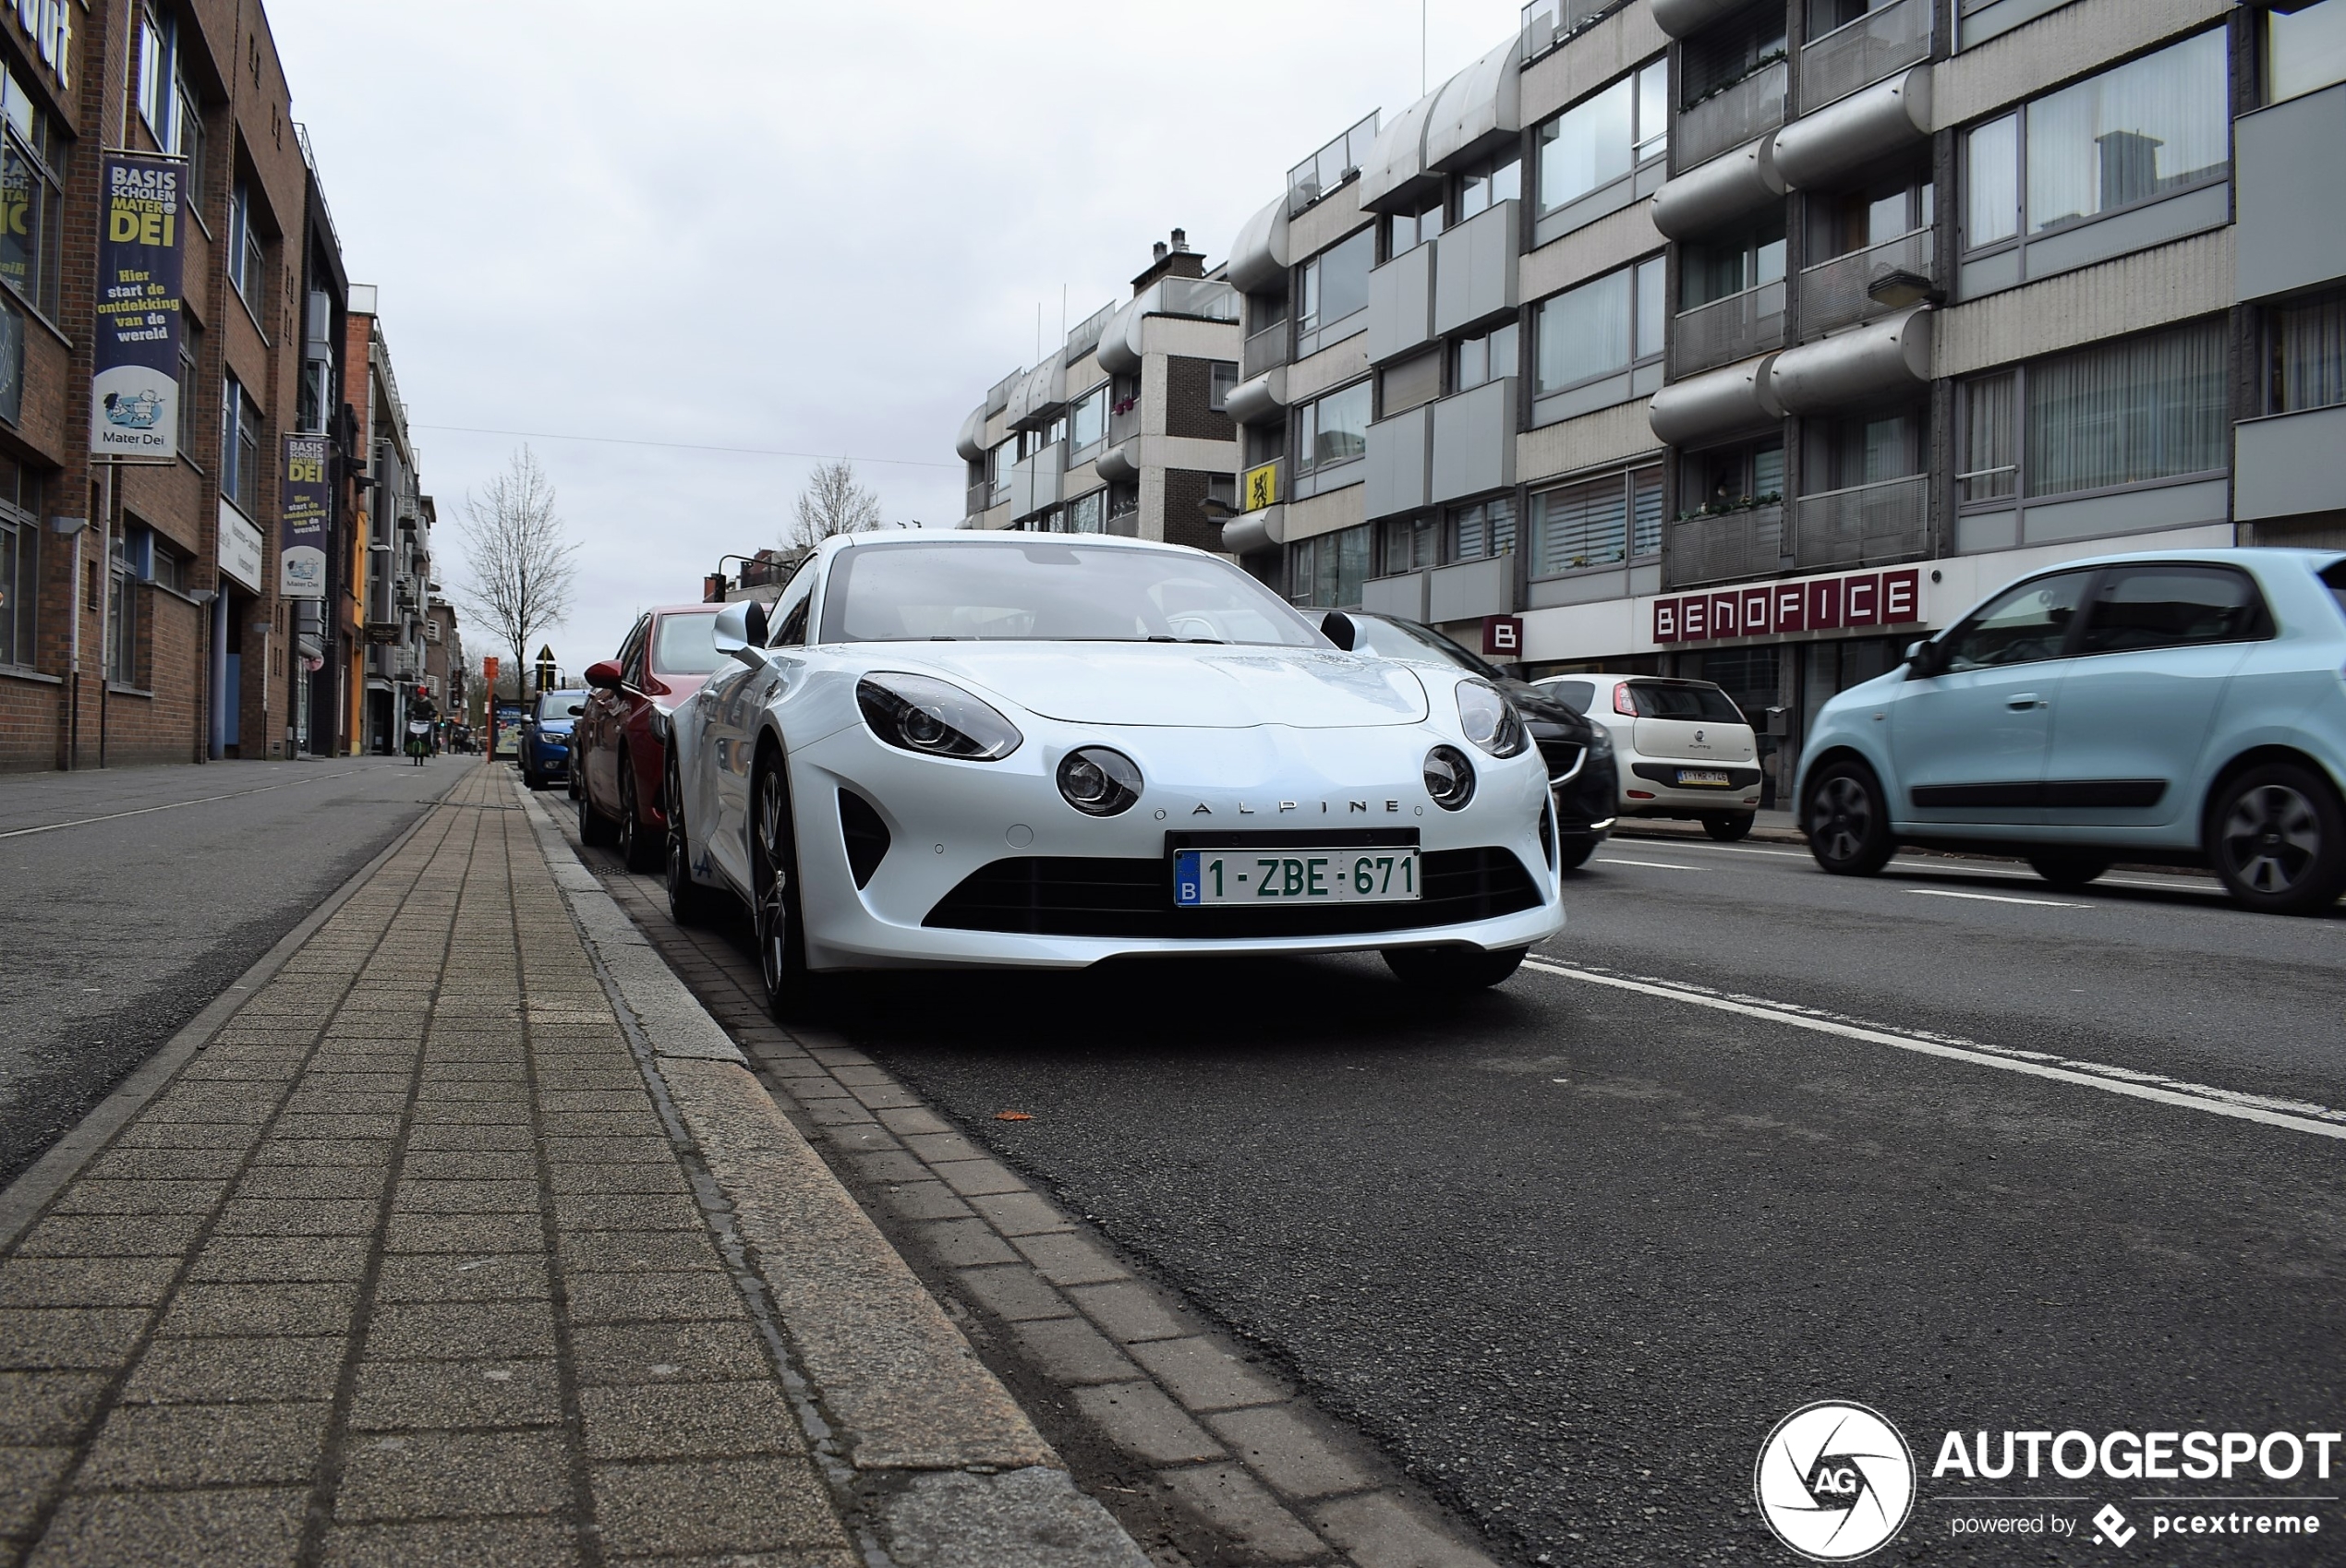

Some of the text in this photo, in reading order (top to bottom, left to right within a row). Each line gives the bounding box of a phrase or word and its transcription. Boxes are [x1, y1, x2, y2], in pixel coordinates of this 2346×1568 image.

[112, 166, 176, 190] BASIS
[111, 185, 175, 202] SCHOLEN
[111, 197, 163, 213] MATER
[109, 210, 175, 247] DEI
[118, 270, 150, 283] Hier
[107, 283, 165, 297] start de
[97, 297, 180, 314] ontdekking
[115, 312, 165, 327] van de
[117, 326, 168, 343] wereld
[103, 431, 164, 445] Mater Dei
[289, 440, 324, 452] BASIS
[288, 464, 323, 483] DEI
[1657, 580, 1912, 635] BENOFICE
[1495, 624, 1517, 648] B
[1191, 800, 1399, 814] ALPINE
[1180, 882, 1197, 901] B
